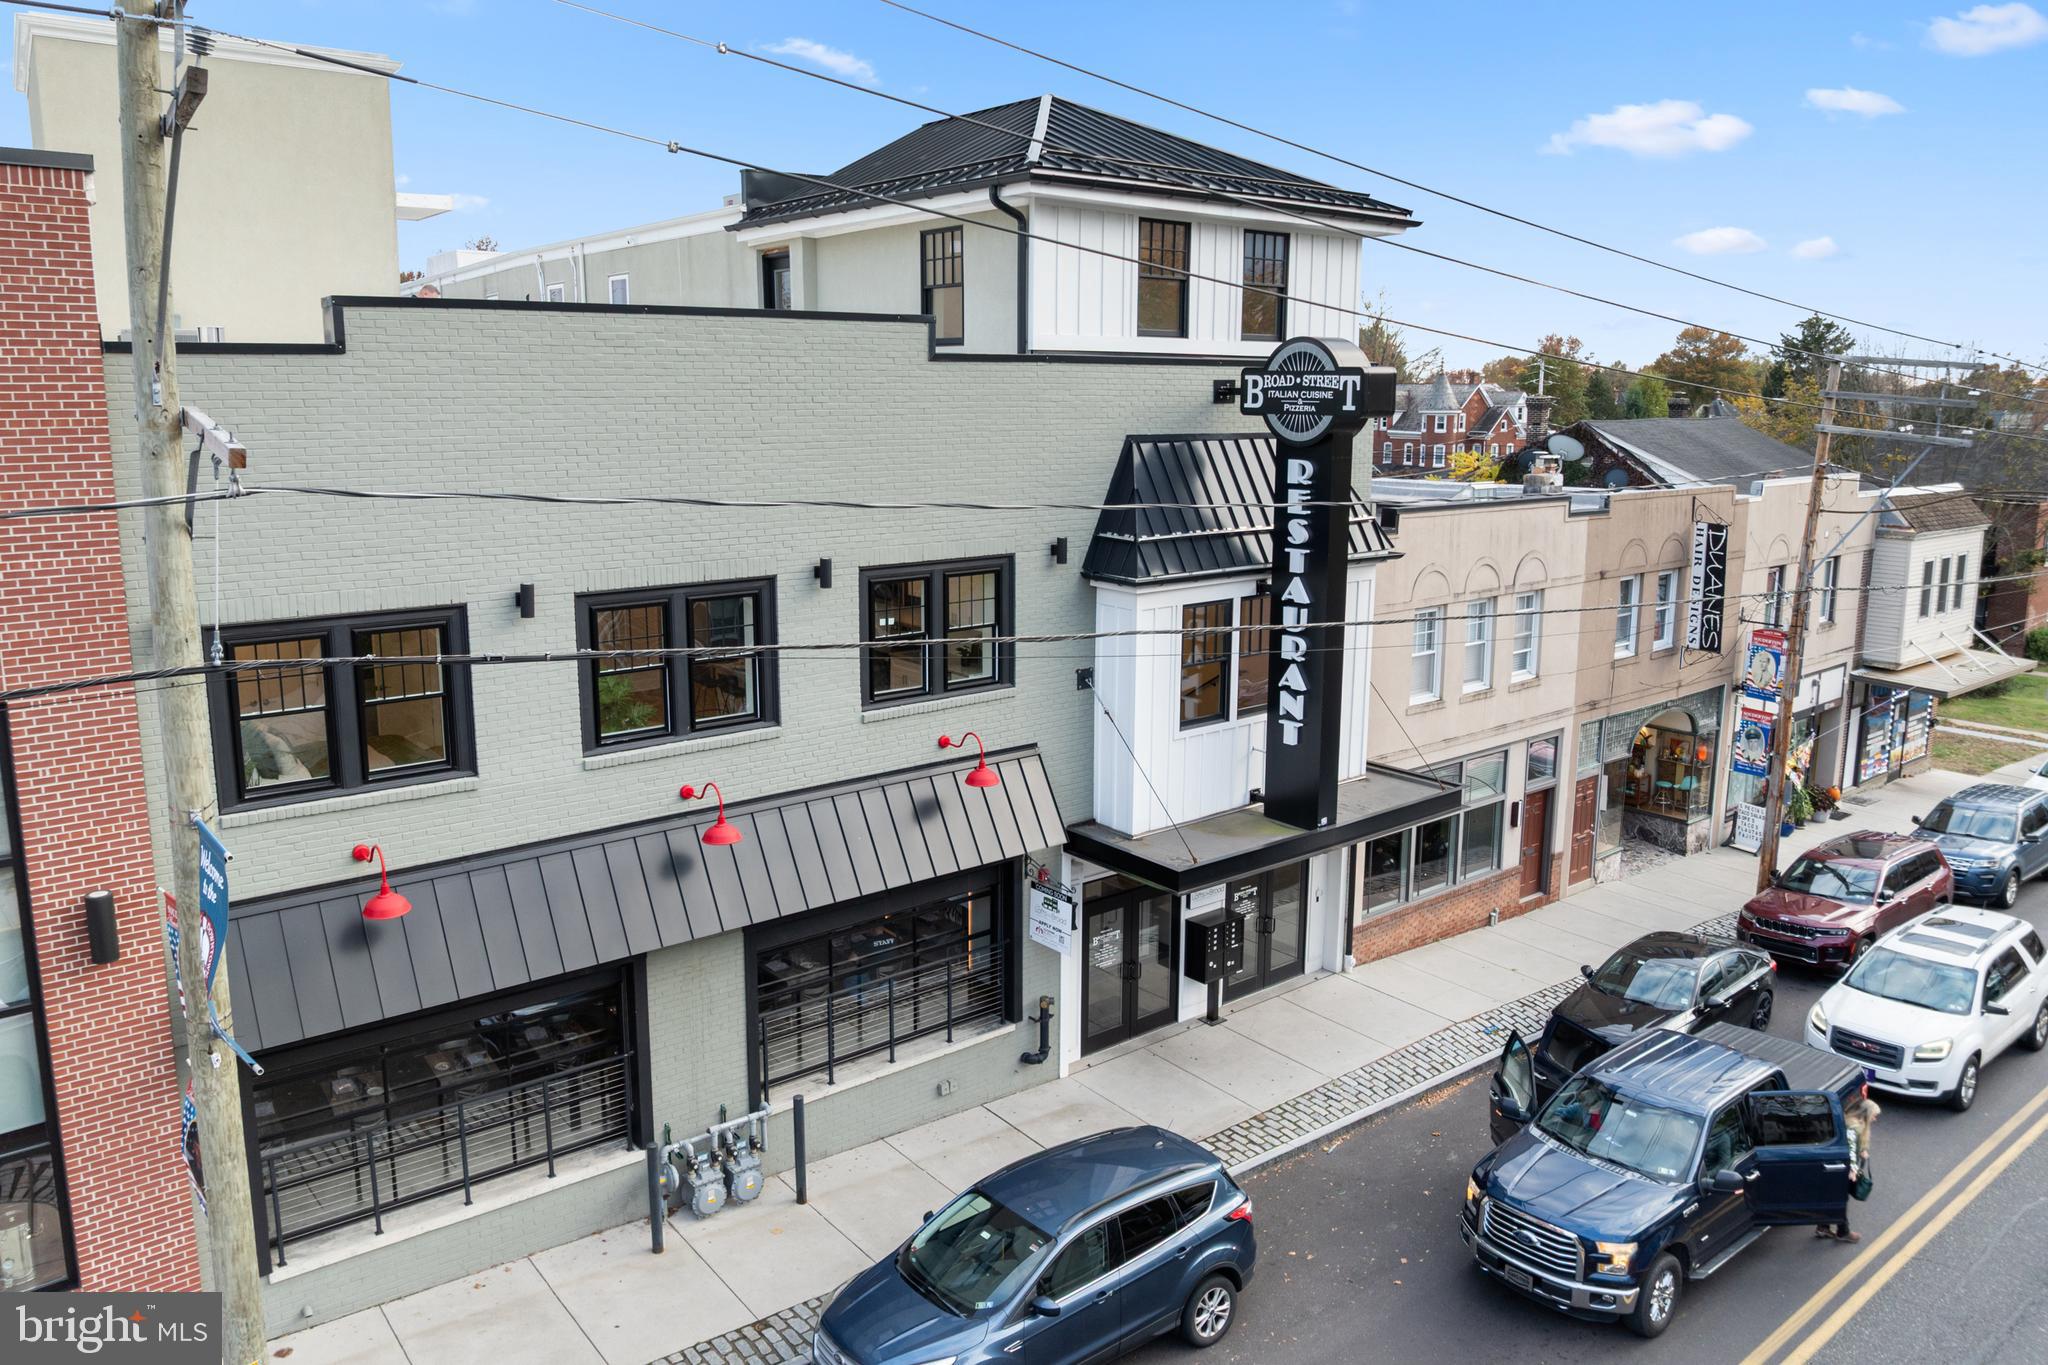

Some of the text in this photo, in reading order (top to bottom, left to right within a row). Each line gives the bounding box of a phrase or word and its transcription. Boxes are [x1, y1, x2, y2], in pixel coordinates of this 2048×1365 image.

[1244, 374, 1361, 411] BROAD STREET
[1268, 390, 1334, 399] ITALIAN CUISINE
[1283, 403, 1316, 412] PIZZERIA
[1694, 527, 1704, 566] HAIR
[1702, 528, 1727, 649] DUANES
[1278, 458, 1315, 746] RESTAURANT
[1740, 820, 1759, 830] TACOS
[200, 845, 224, 890] Welcome
[202, 878, 217, 904] to the
[1035, 883, 1067, 902] COMING SOON
[873, 937, 895, 947] STAFF
